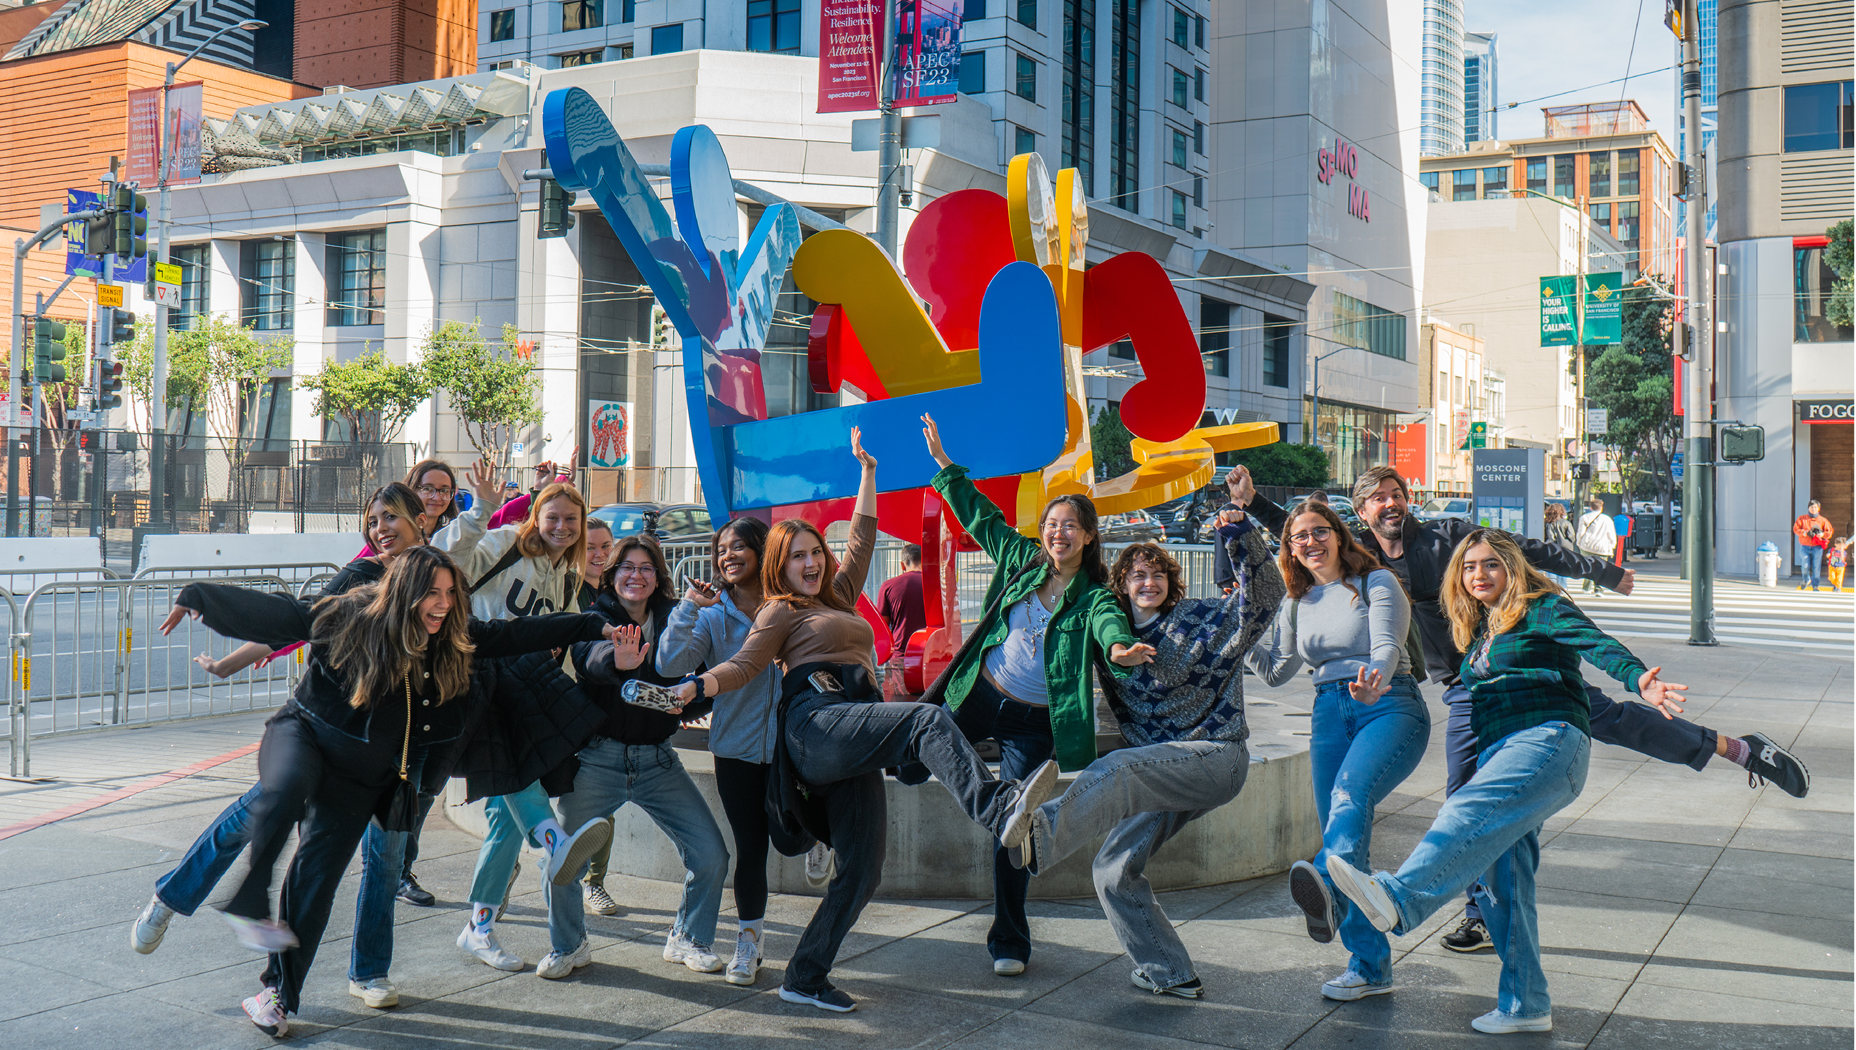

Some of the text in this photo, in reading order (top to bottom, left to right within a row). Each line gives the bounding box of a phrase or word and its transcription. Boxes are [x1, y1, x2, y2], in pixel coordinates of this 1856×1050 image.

[824, 4, 881, 16] Sustainability.
[830, 17, 873, 28] Resilience.
[827, 44, 874, 57] Attendees
[903, 52, 950, 70] APEC
[902, 68, 950, 88] SF23
[828, 91, 870, 100] apec2023sf.org
[171, 147, 196, 159] APEC
[170, 158, 196, 171] SF23
[100, 288, 121, 296] TRANSIT
[1542, 298, 1561, 306] YOUR
[1543, 306, 1568, 315] HIGHER
[1542, 323, 1573, 331] CALLING.
[515, 339, 535, 360] W
[1214, 409, 1238, 426] W
